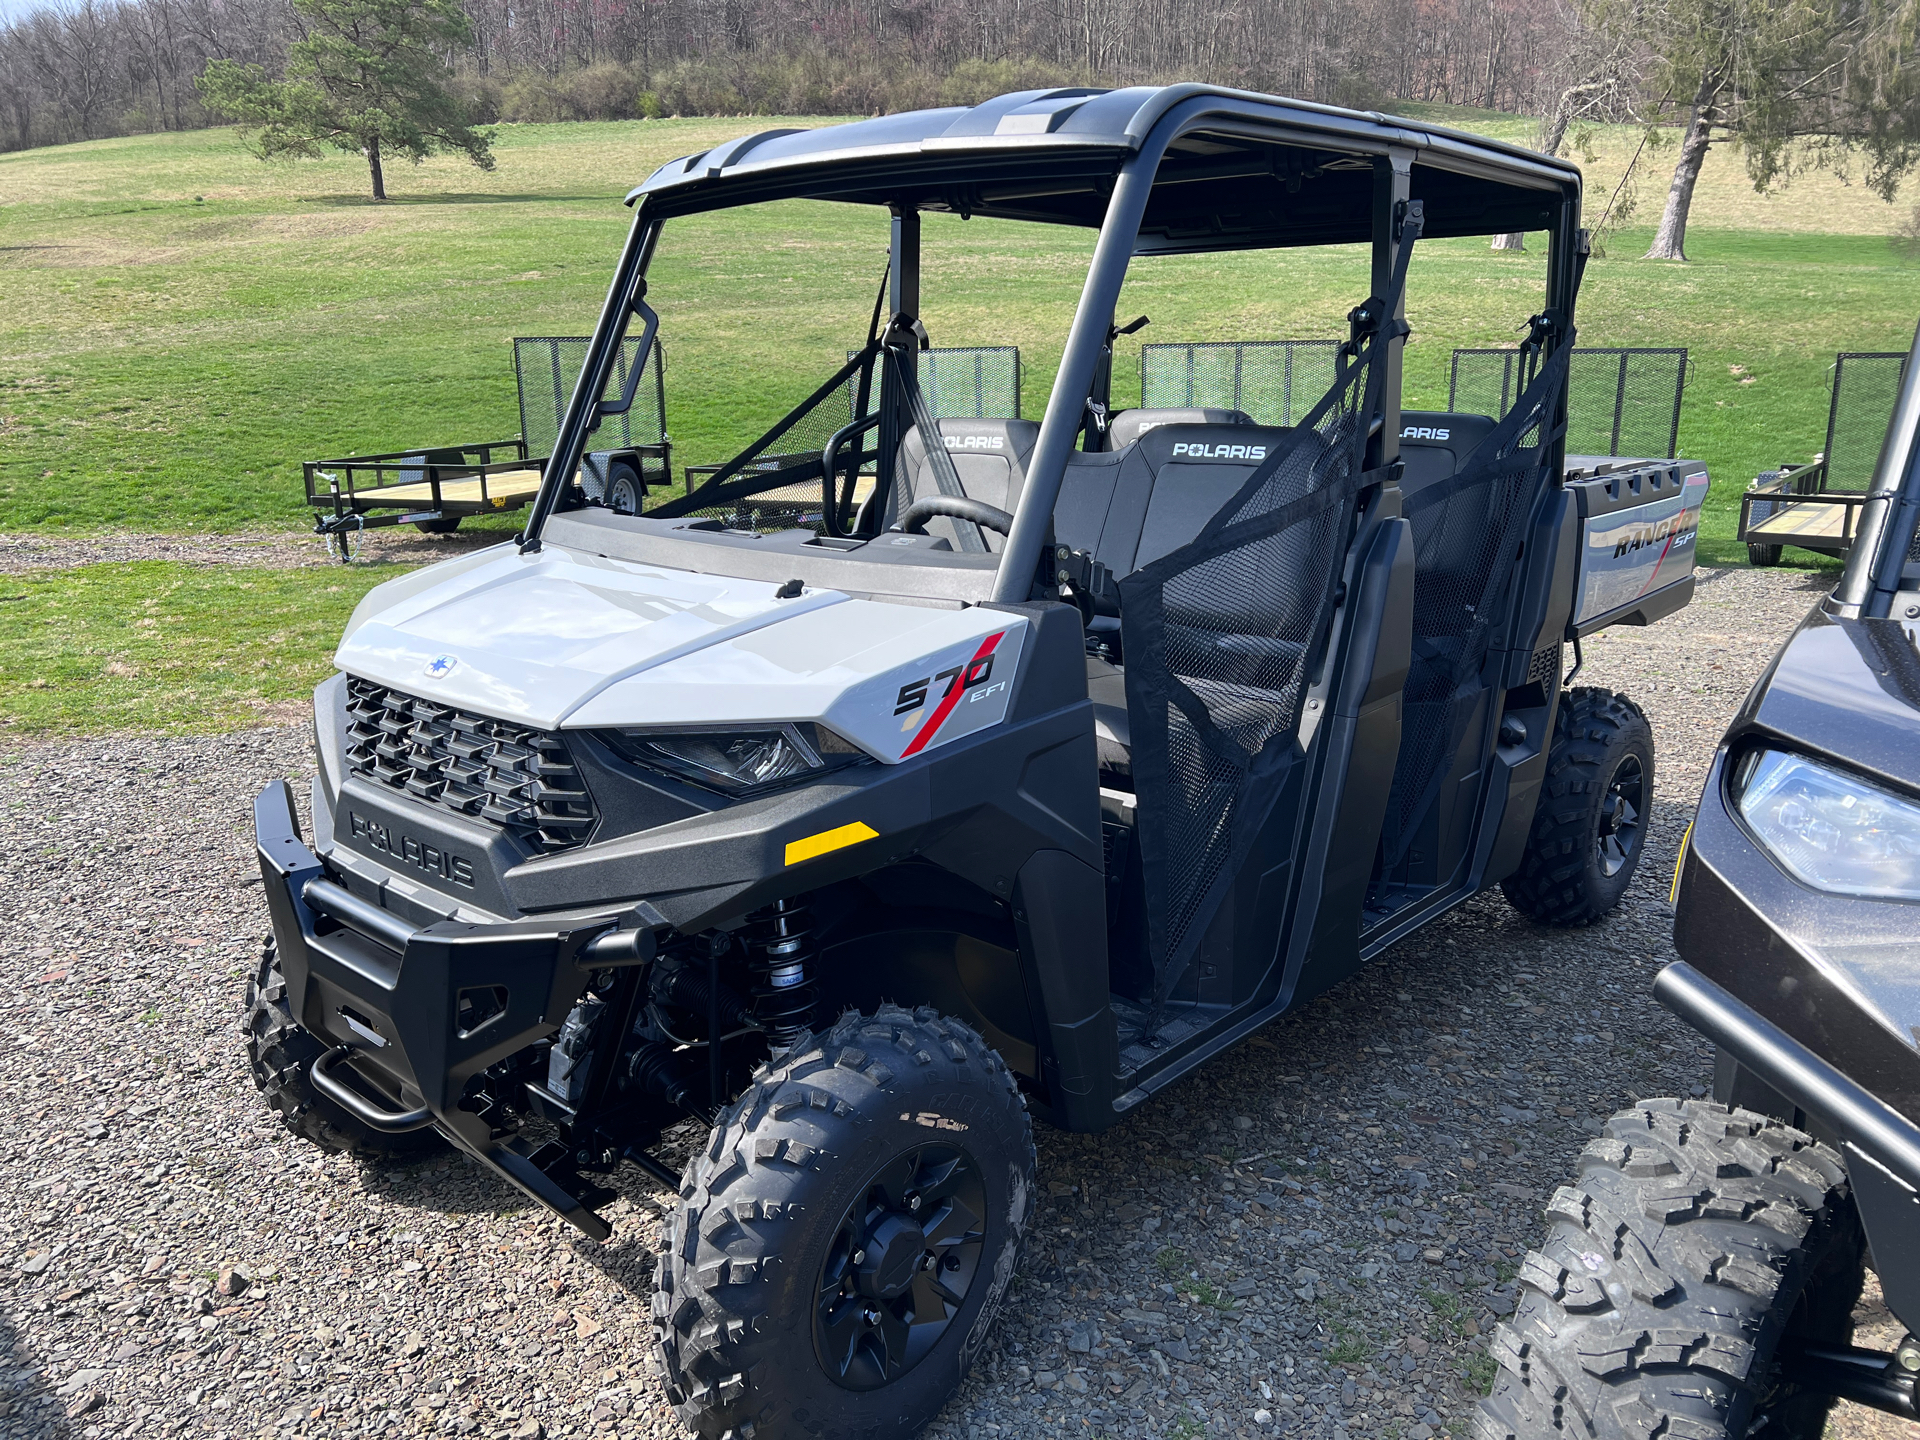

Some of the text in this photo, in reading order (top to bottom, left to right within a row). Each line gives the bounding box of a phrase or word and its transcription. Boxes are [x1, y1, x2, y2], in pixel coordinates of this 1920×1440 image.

[941, 435, 1004, 449] OLARIS
[1172, 442, 1267, 460] POLARIS
[1612, 512, 1694, 560] RANGER
[1672, 531, 1696, 549] SP
[893, 653, 996, 716] 570
[969, 681, 1006, 703] EFI
[349, 810, 475, 890] POLARIS
